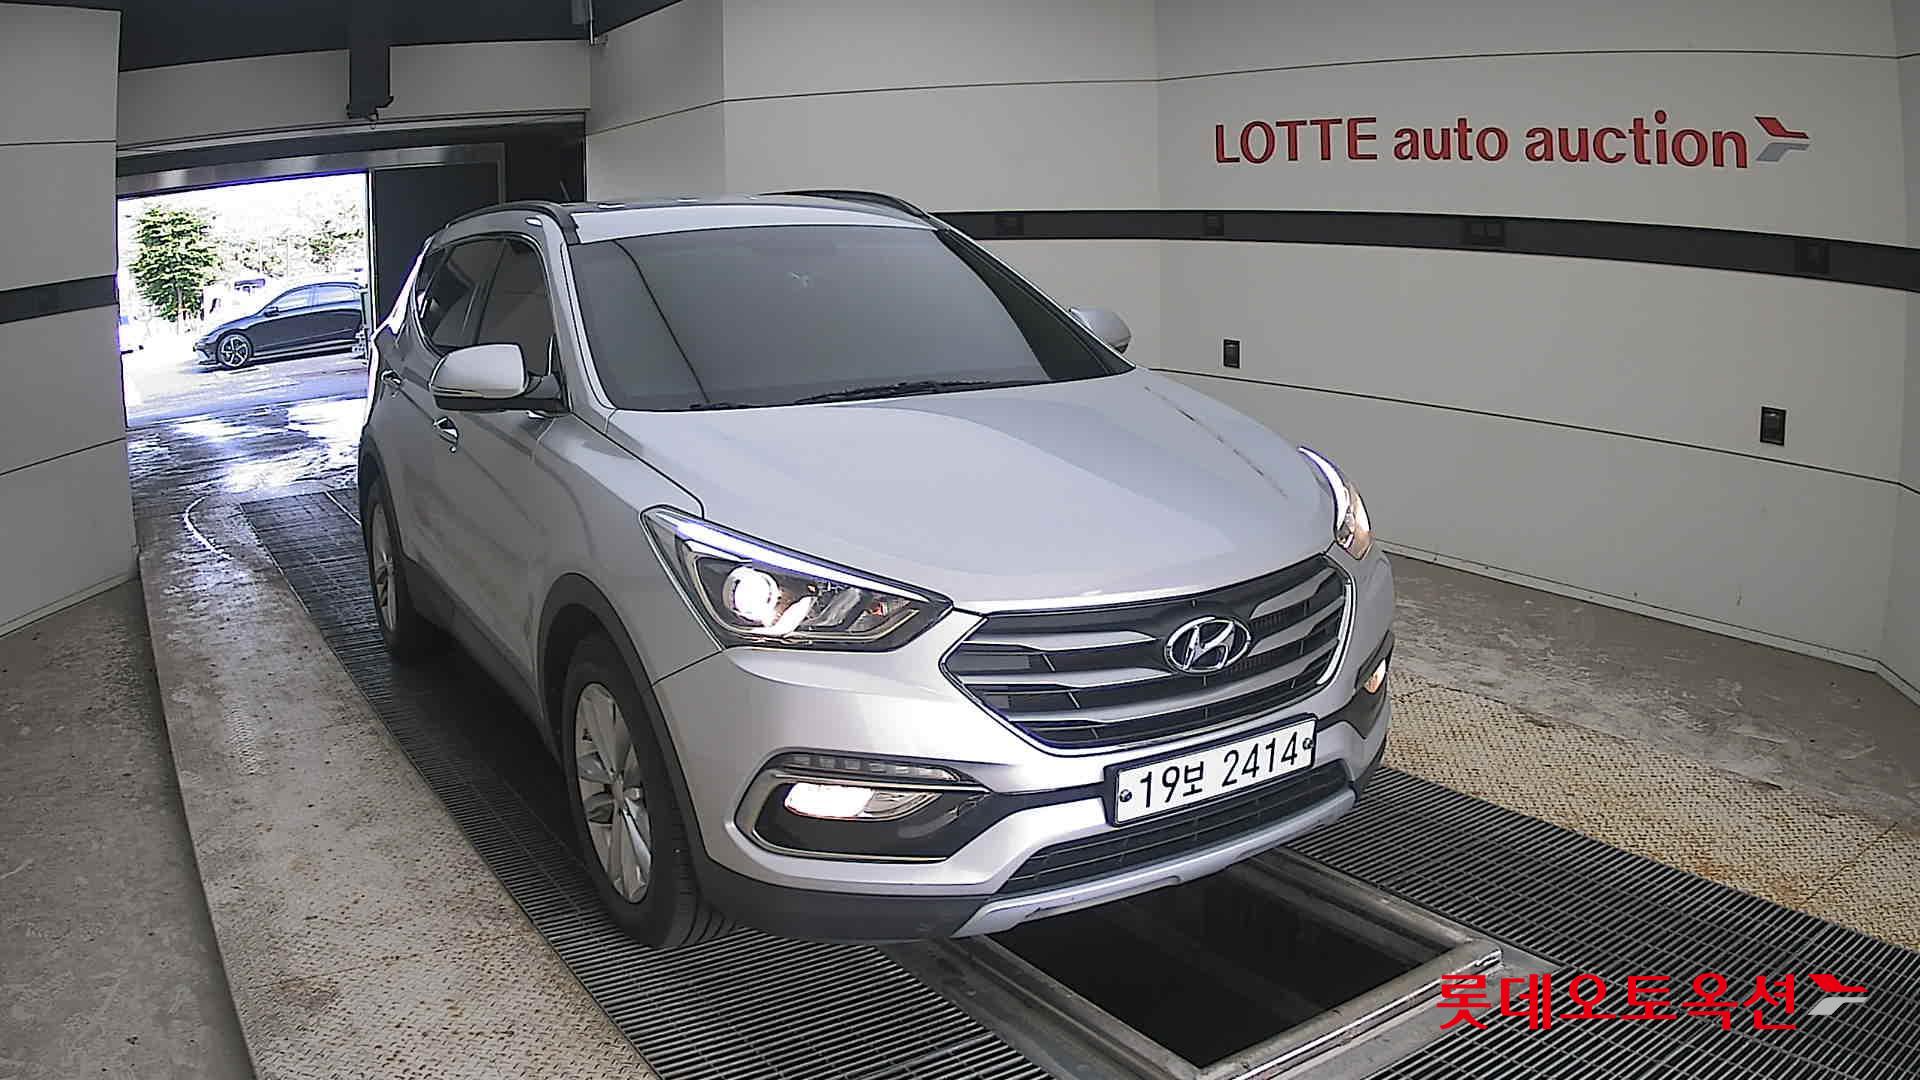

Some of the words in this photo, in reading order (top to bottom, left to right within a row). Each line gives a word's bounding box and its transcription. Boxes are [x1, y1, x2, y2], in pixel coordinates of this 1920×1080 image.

[1215, 116, 1377, 164] LOTTE
[1393, 118, 1509, 161] auto
[1525, 109, 1748, 168] auction
[1140, 761, 1204, 808] 19보
[1221, 731, 1298, 788] 2414
